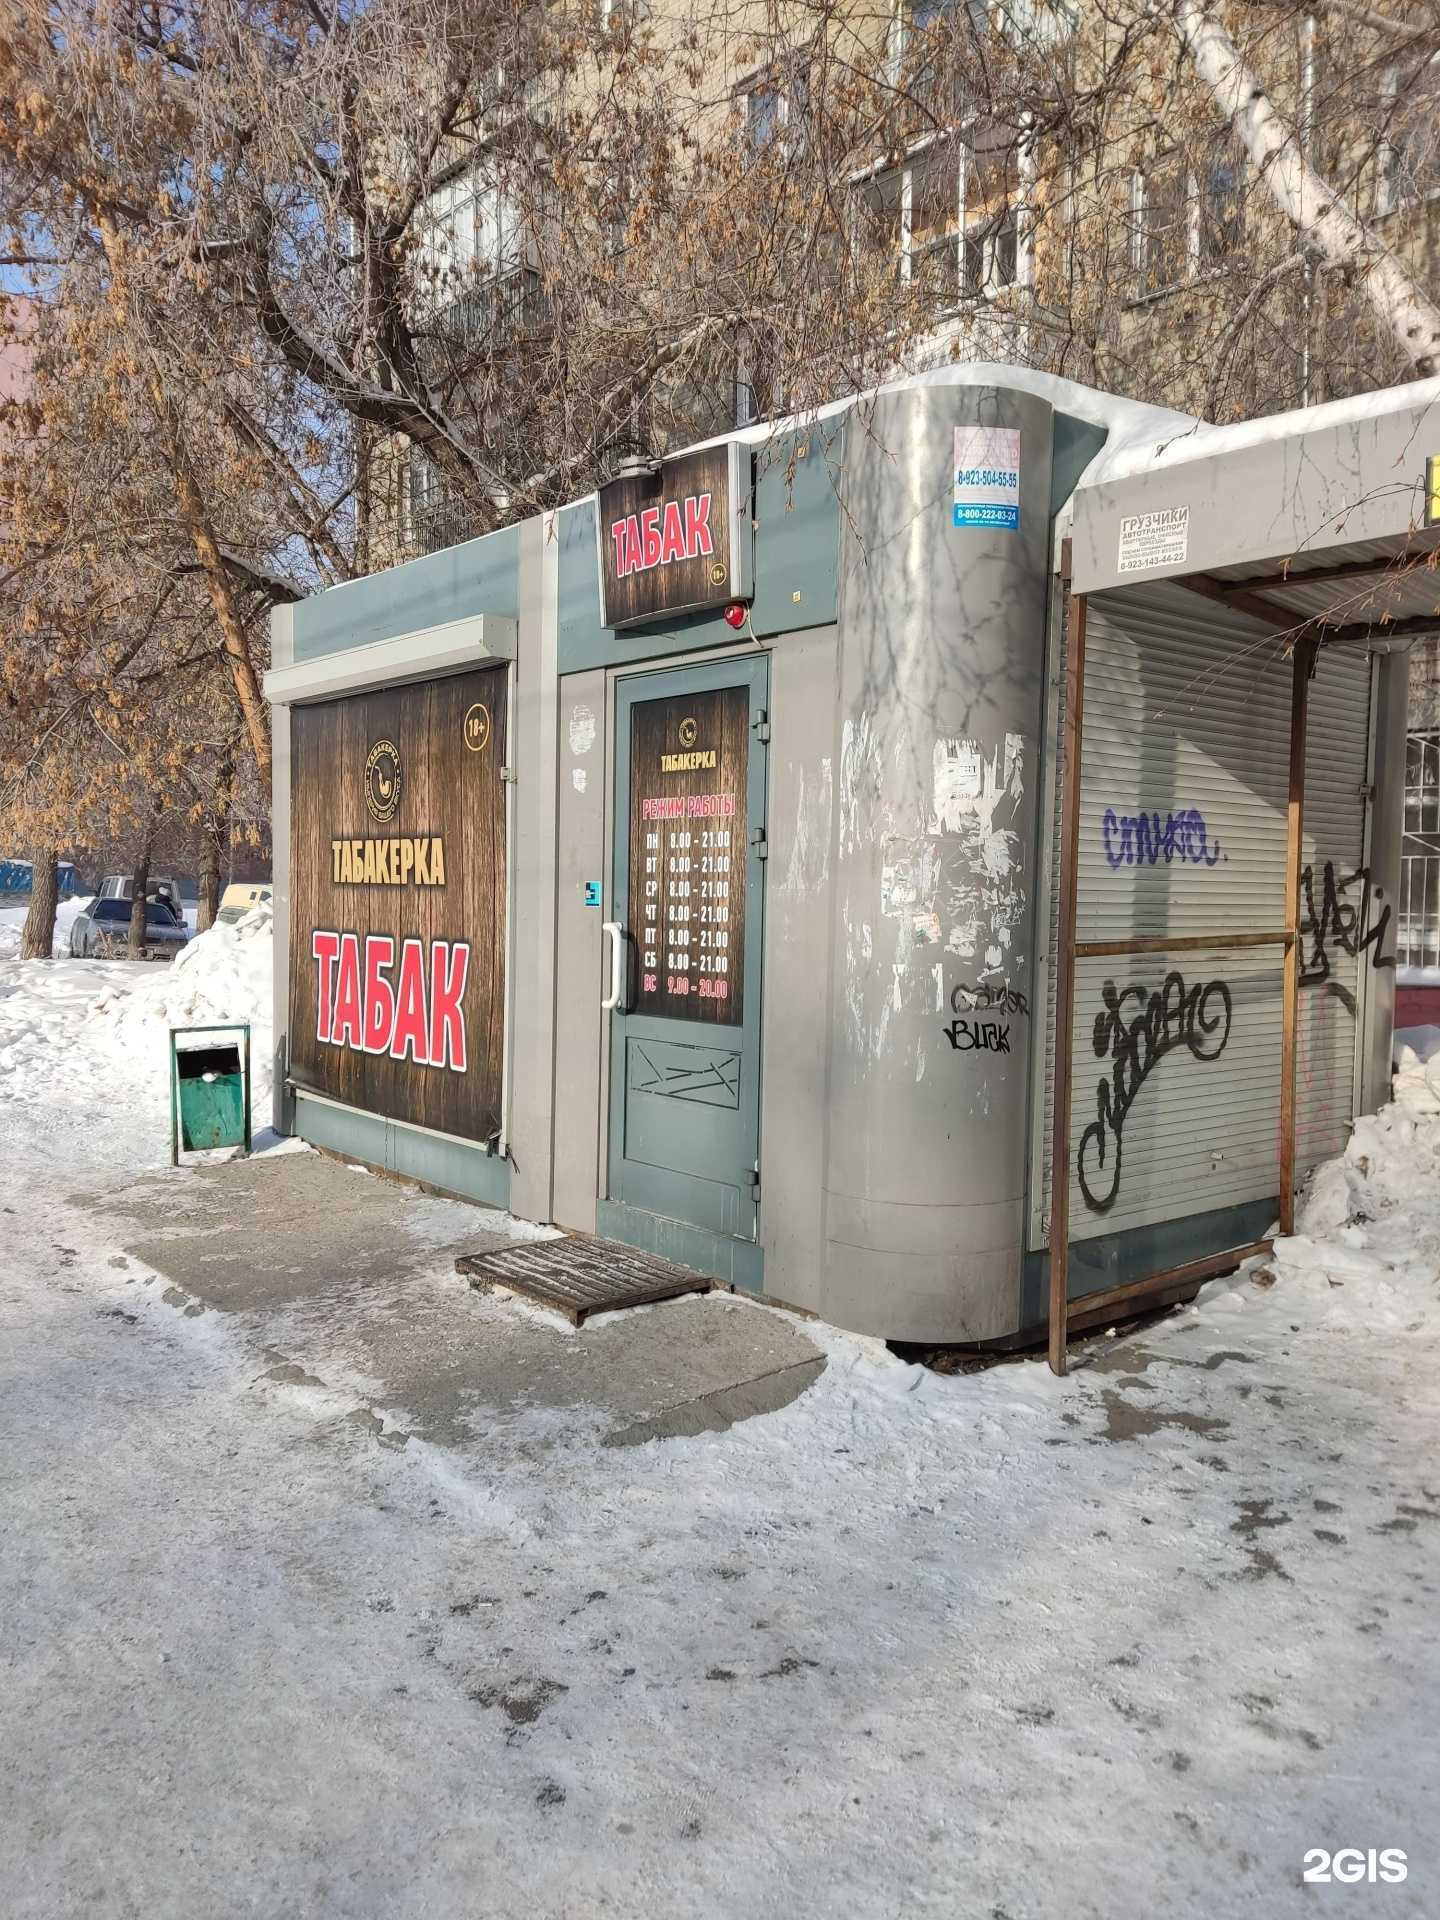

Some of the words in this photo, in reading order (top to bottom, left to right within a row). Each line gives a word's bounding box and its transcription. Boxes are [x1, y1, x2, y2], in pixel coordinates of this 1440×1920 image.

[1122, 508, 1188, 532] ГРУЗЧИКИ
[1122, 522, 1186, 539] АВТОТРАНСПОРТ
[611, 493, 713, 578] ТАБАК
[469, 718, 485, 737] 18+
[661, 750, 717, 772] ТАБАКЕРКА
[642, 797, 685, 820] РЕЖИМ
[688, 793, 736, 817] РАБОТЫ
[646, 833, 659, 849] ПН
[670, 832, 691, 849] 8.00
[702, 831, 730, 848] 21.00
[331, 837, 446, 885] ТАБАКЕРКА
[646, 857, 658, 873] ВТ
[669, 857, 691, 873] 8.00
[702, 856, 729, 873] 21.00
[646, 881, 657, 897] СР
[669, 881, 690, 897] 8.00
[701, 881, 729, 898] 21.00
[645, 905, 657, 920] ЧТ
[669, 905, 690, 922] 8.00
[700, 905, 729, 923] 21.00
[645, 928, 657, 944] ПТ
[668, 929, 690, 946] 8.00
[700, 930, 728, 948] 21.00
[644, 951, 656, 968] СБ
[668, 953, 689, 970] 8.00
[699, 955, 728, 973] 21.00
[644, 973, 657, 992] ВС
[667, 975, 689, 995] 9.00
[699, 979, 728, 998] 20.00
[312, 930, 470, 1073] ТАБАК
